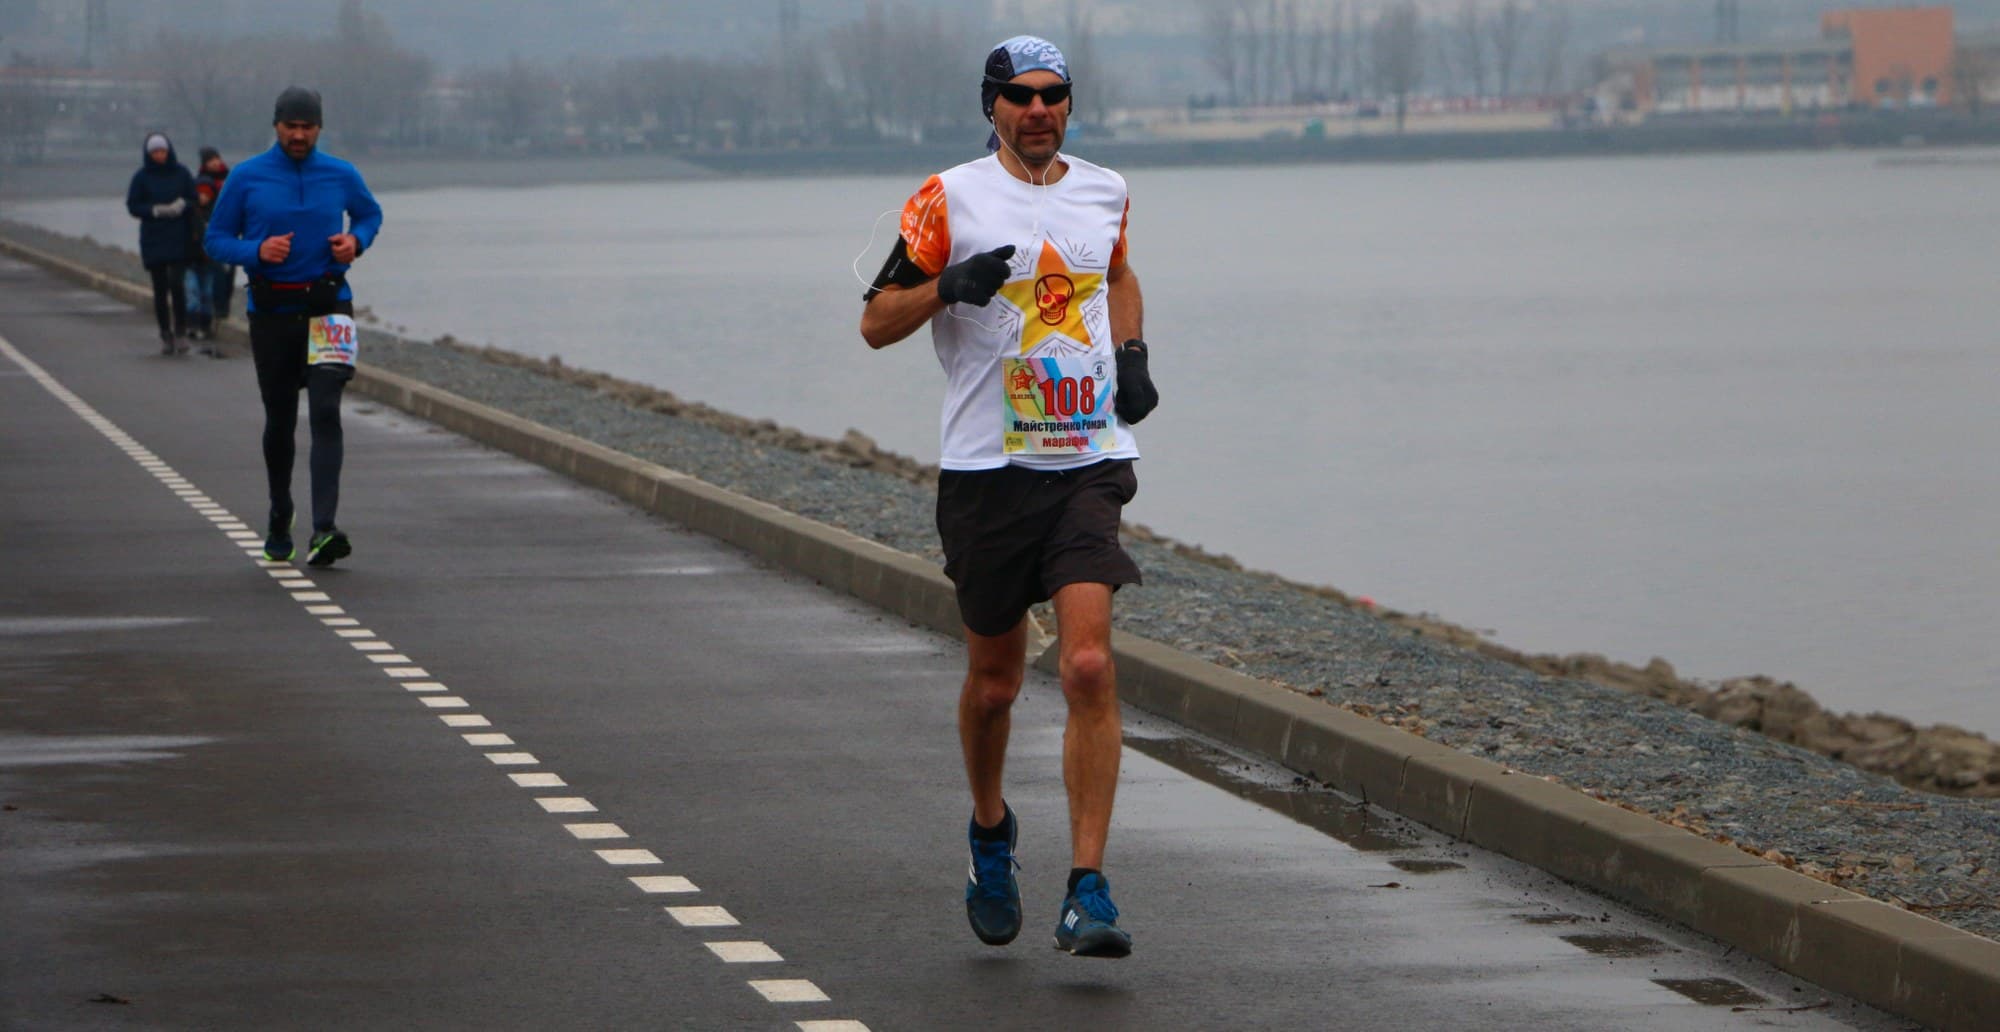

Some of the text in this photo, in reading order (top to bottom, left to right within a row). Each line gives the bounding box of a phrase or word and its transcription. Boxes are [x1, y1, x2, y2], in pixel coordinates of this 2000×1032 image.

[326, 323, 352, 345] 126
[1038, 376, 1095, 416] 108
[1013, 419, 1107, 432] Майстренко Роман
[1042, 436, 1089, 448] марафон
